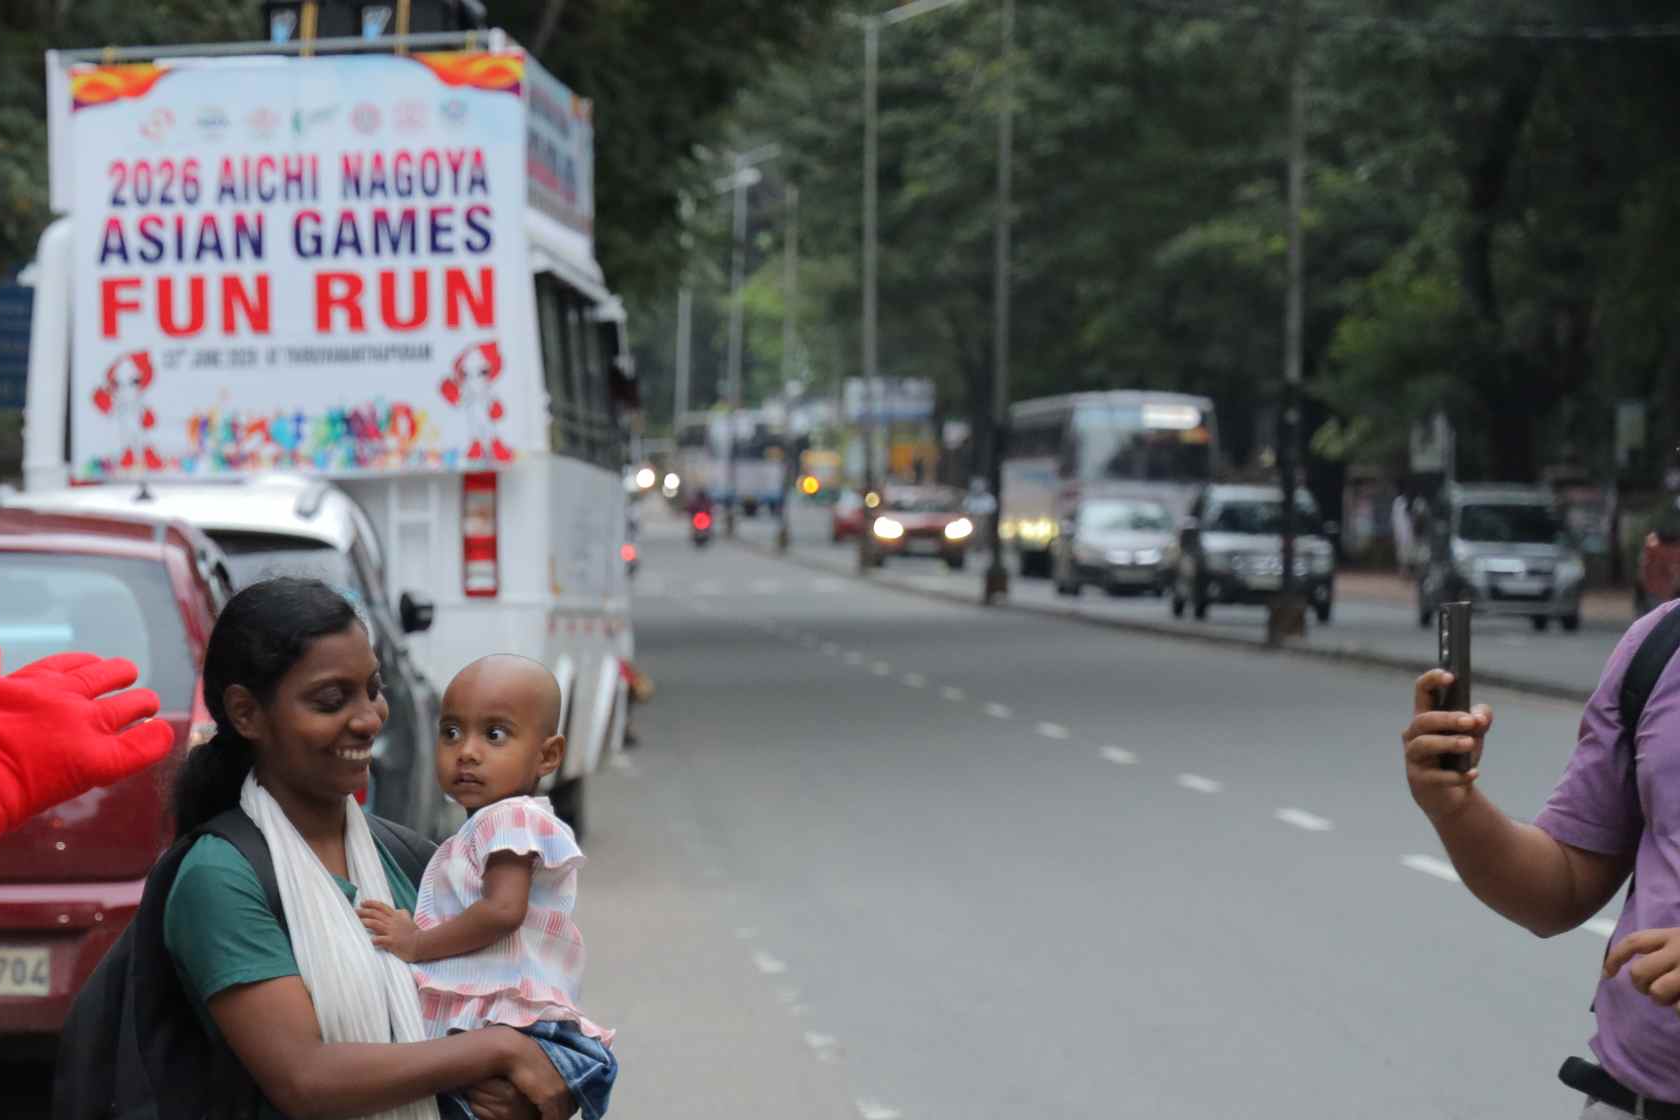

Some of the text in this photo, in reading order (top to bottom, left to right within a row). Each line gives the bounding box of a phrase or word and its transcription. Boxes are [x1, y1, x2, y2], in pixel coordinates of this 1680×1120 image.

[109, 158, 201, 209] 2026
[217, 154, 319, 205] AICHI
[340, 147, 489, 199] NAGOYA
[97, 203, 493, 266] ASIAN GAMES
[99, 266, 497, 339] FUN RUN
